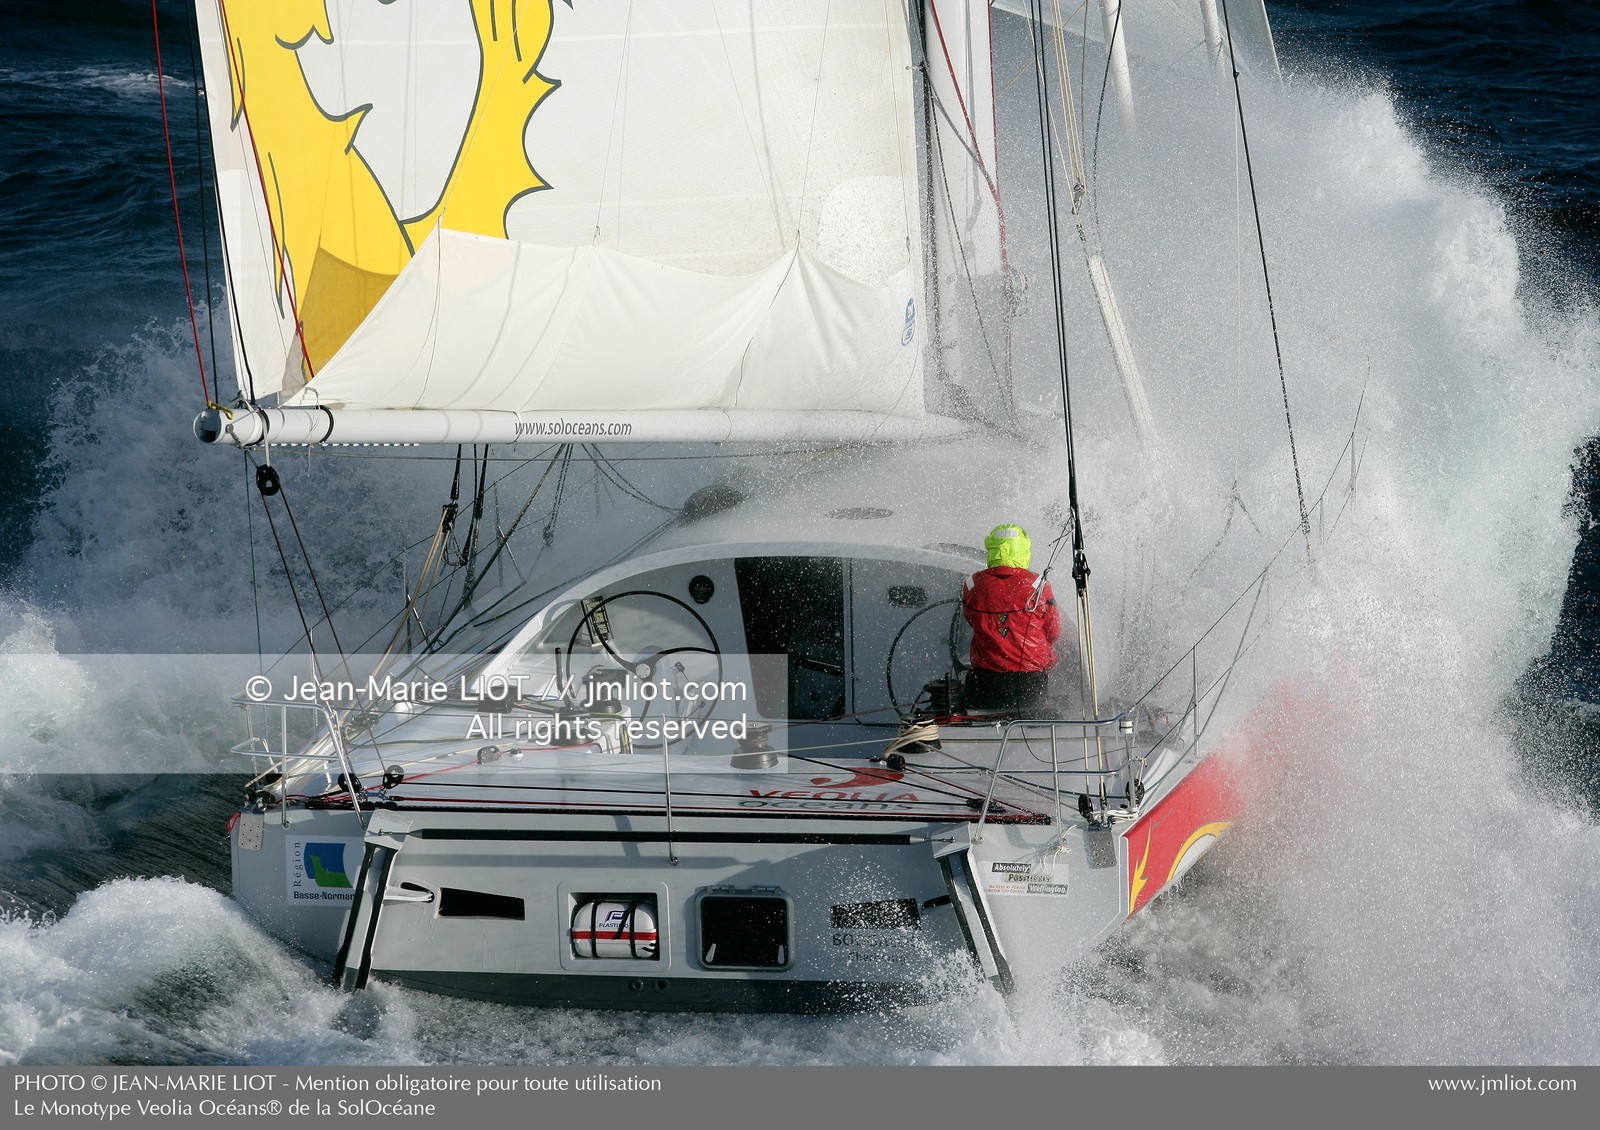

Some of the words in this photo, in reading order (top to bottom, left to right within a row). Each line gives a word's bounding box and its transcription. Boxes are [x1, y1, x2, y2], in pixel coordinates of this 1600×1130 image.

[514, 418, 632, 436] www.soloceans.com
[750, 789, 919, 802] VEOLIA
[292, 842, 303, 887] Région
[994, 863, 1029, 873] Absolutely
